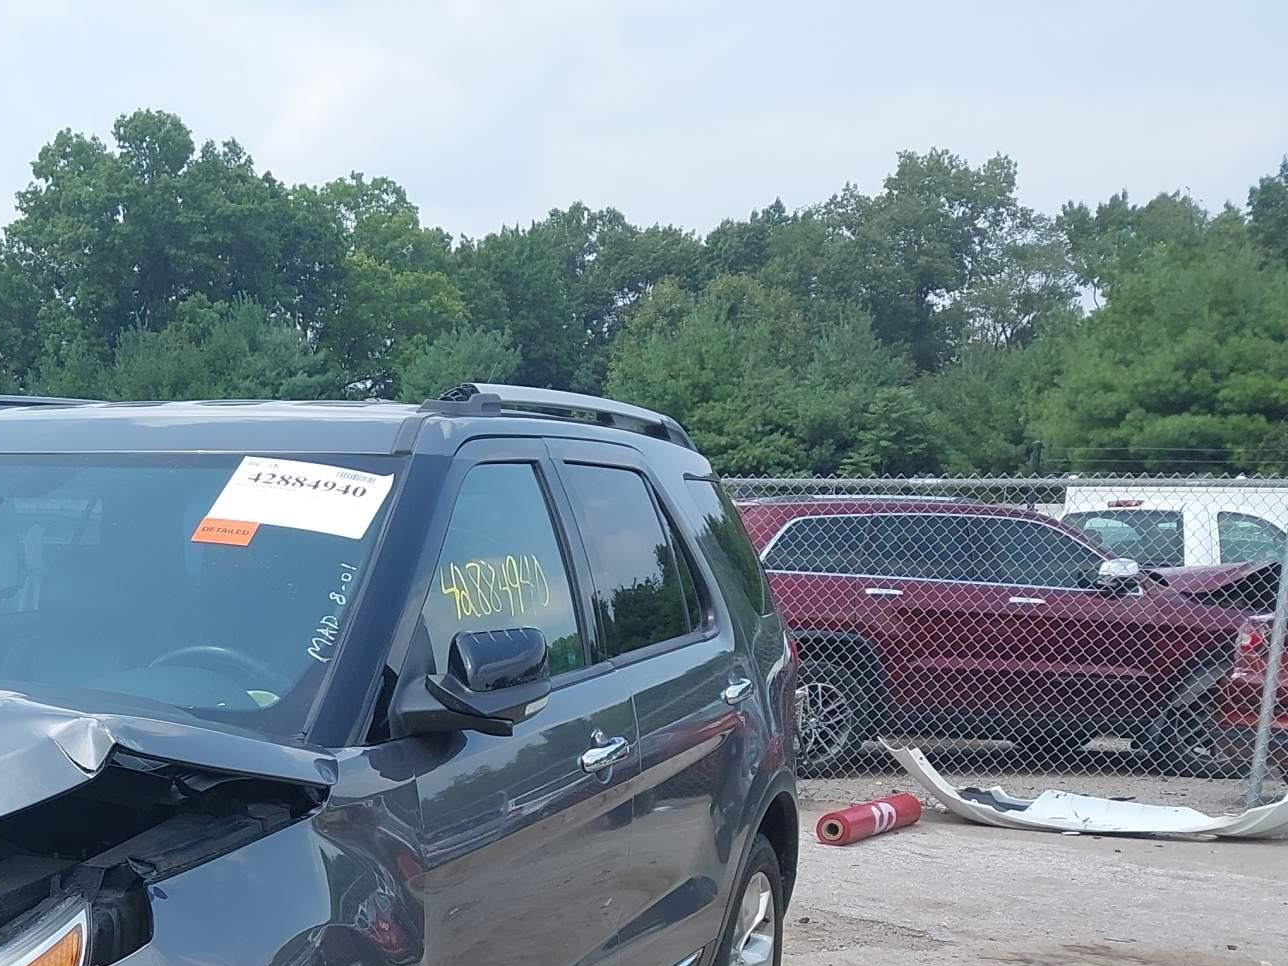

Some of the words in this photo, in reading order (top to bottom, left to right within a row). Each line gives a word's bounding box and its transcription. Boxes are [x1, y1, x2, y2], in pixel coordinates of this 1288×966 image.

[247, 471, 368, 498] 42884940
[201, 526, 250, 536] DETAILED
[307, 615, 339, 662] MAD
[329, 562, 357, 605] 8-01
